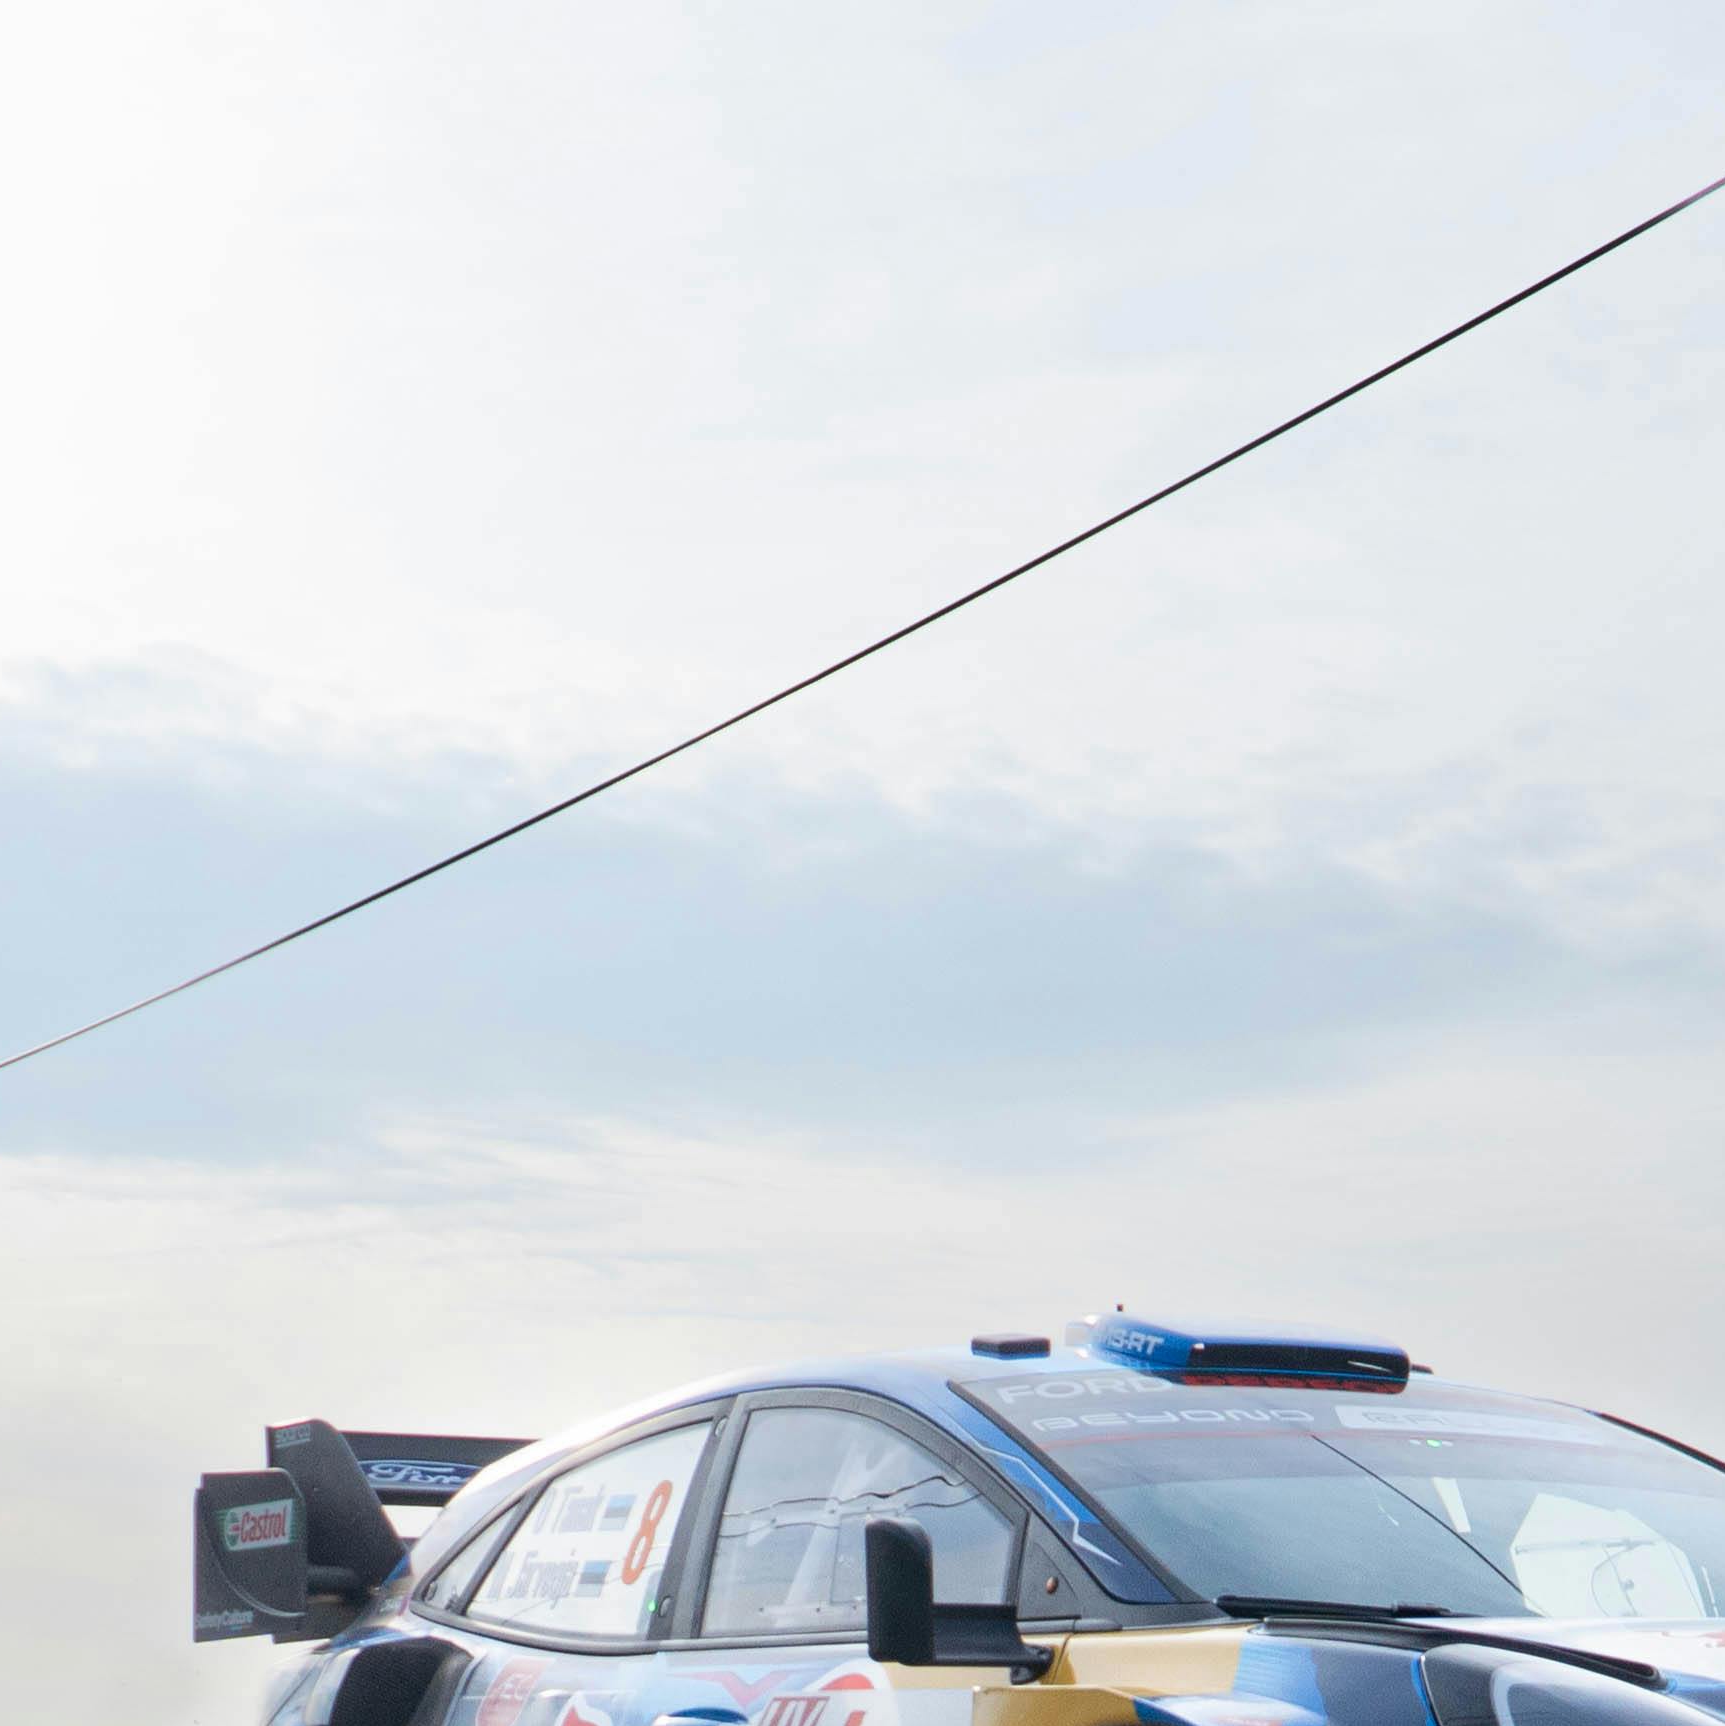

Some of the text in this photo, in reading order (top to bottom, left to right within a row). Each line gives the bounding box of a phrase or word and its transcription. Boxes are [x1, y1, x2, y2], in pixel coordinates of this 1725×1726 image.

[995, 1375, 1173, 1404] FORD
[1031, 1405, 1315, 1431] BEYOND
[240, 1507, 287, 1543] Castrol
[621, 1479, 673, 1585] 8
